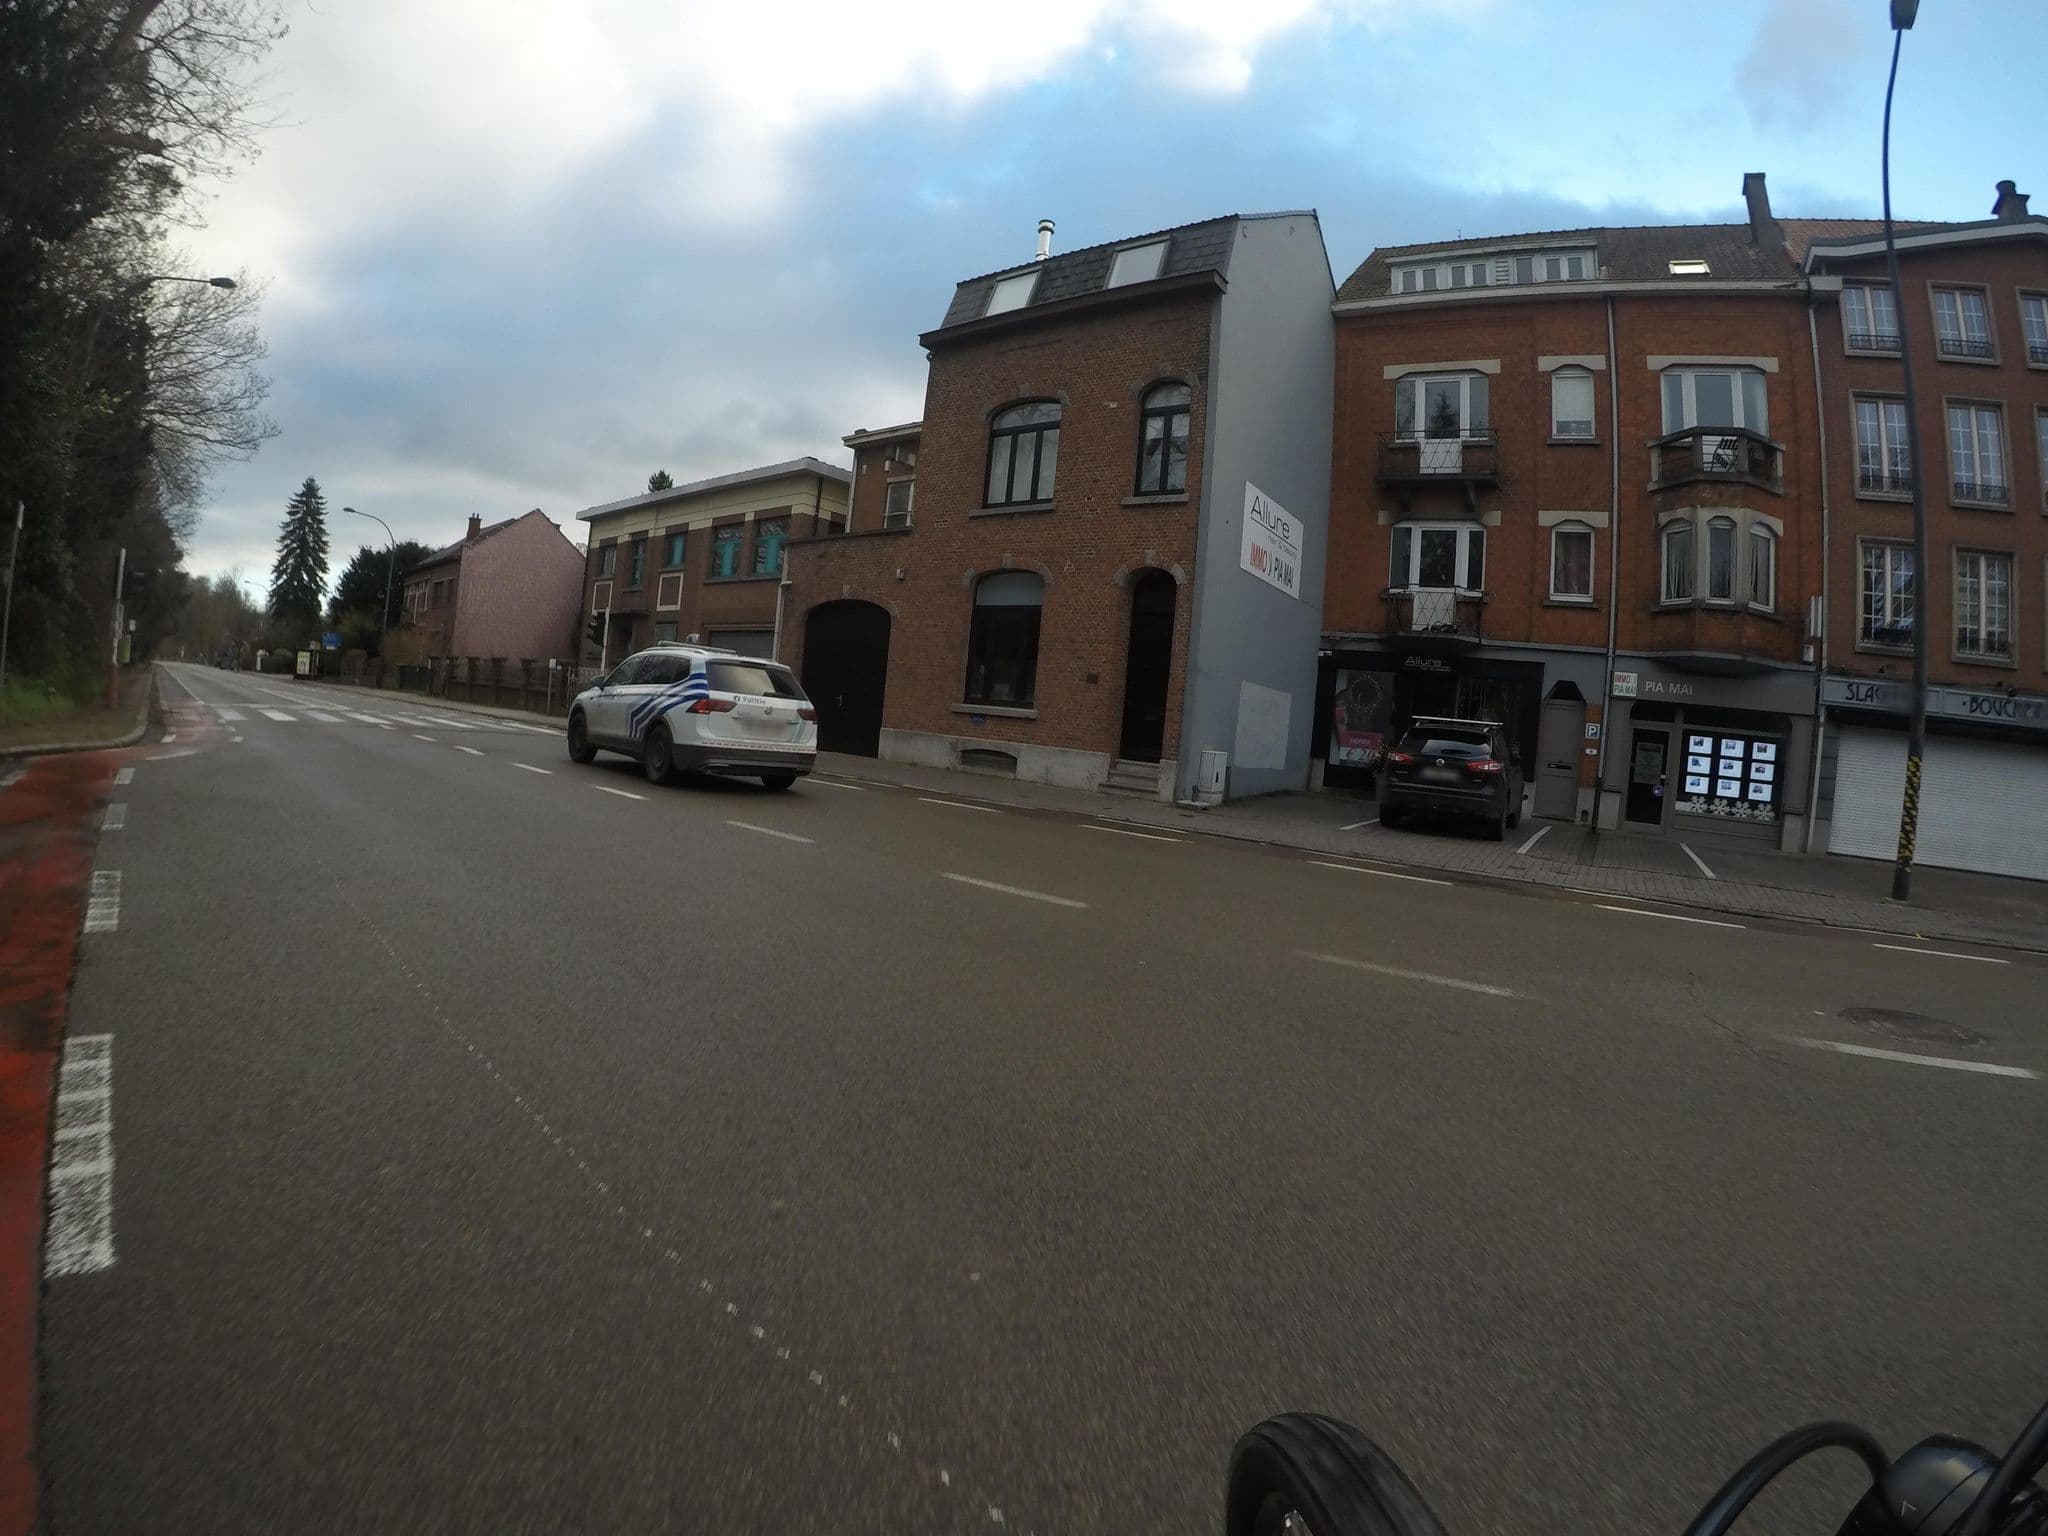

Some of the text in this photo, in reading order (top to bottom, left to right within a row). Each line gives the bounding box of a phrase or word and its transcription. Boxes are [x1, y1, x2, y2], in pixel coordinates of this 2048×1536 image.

[1250, 495, 1290, 539] Allure
[1405, 656, 1442, 667] Allure
[1645, 681, 1693, 696] PIA MAI
